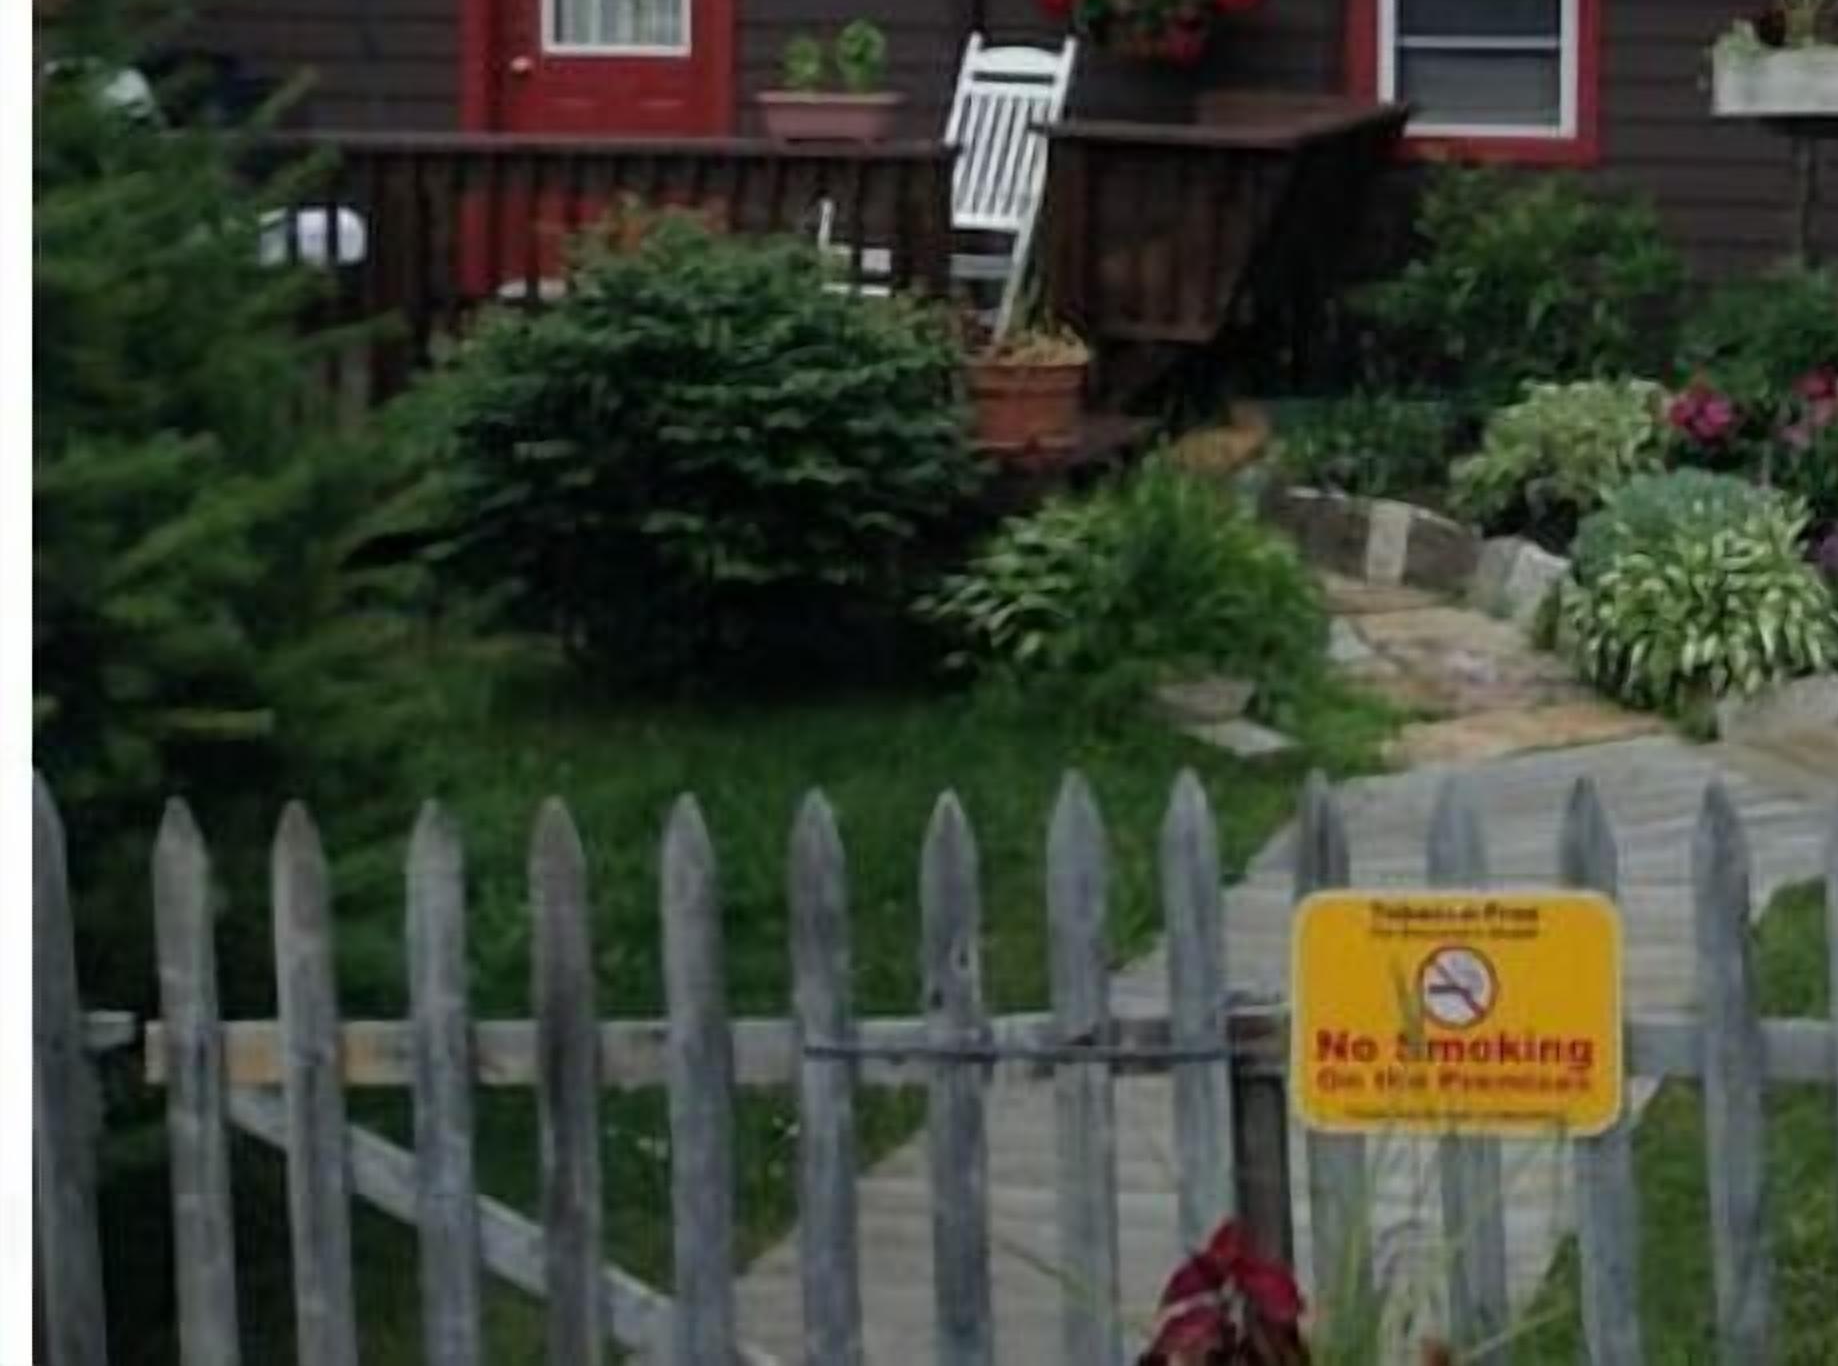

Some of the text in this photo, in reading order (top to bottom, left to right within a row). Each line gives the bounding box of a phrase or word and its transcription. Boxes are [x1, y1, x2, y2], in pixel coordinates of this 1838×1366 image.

[1316, 1030, 1594, 1069] No Smoking
[1317, 1068, 1365, 1091] On
